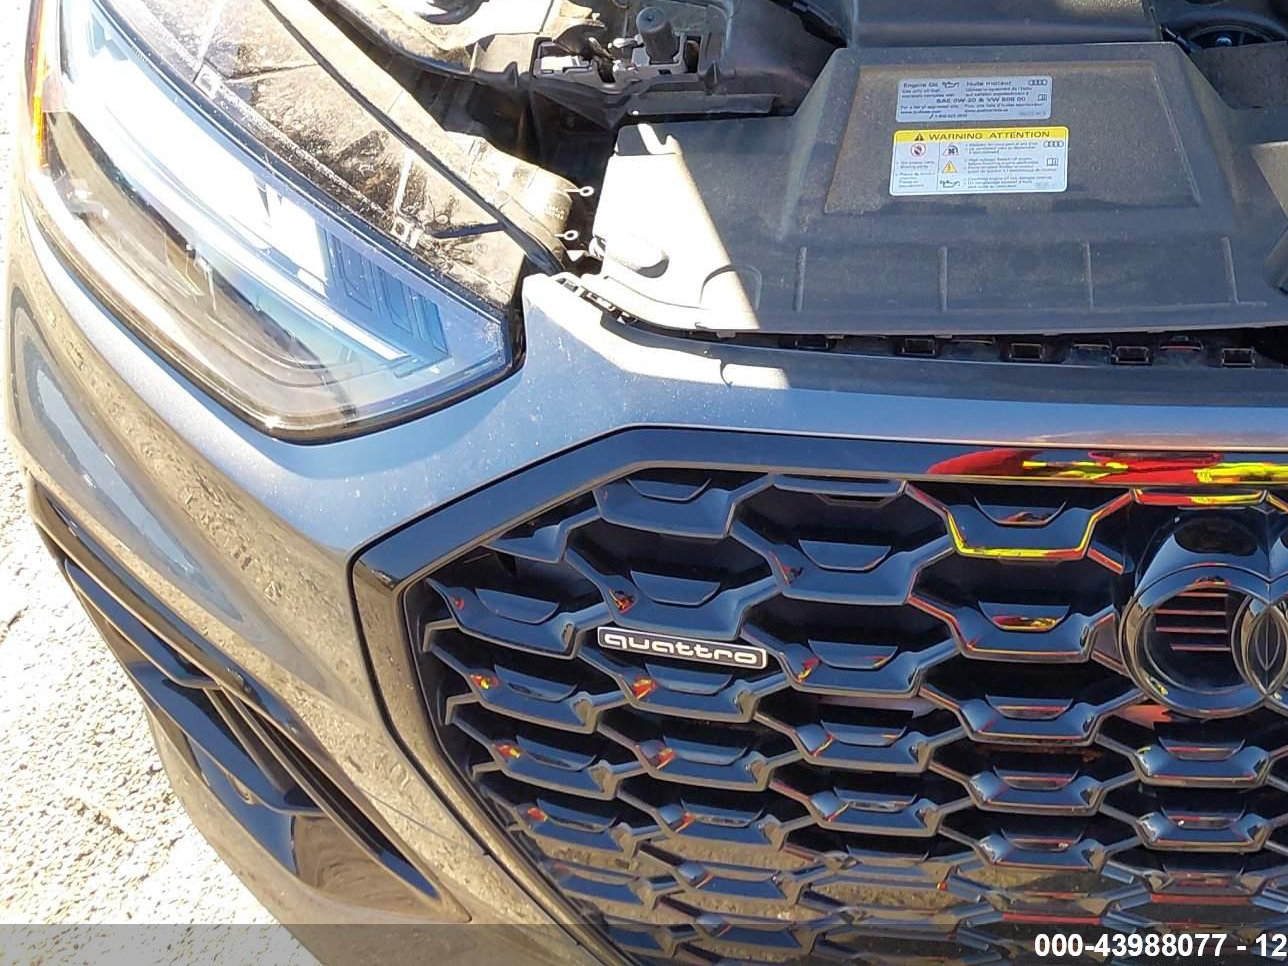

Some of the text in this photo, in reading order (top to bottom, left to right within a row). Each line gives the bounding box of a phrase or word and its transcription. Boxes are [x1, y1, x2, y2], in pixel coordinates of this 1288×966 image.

[928, 131, 1050, 140] WARNING ATTENTION
[604, 633, 757, 664] quattro
